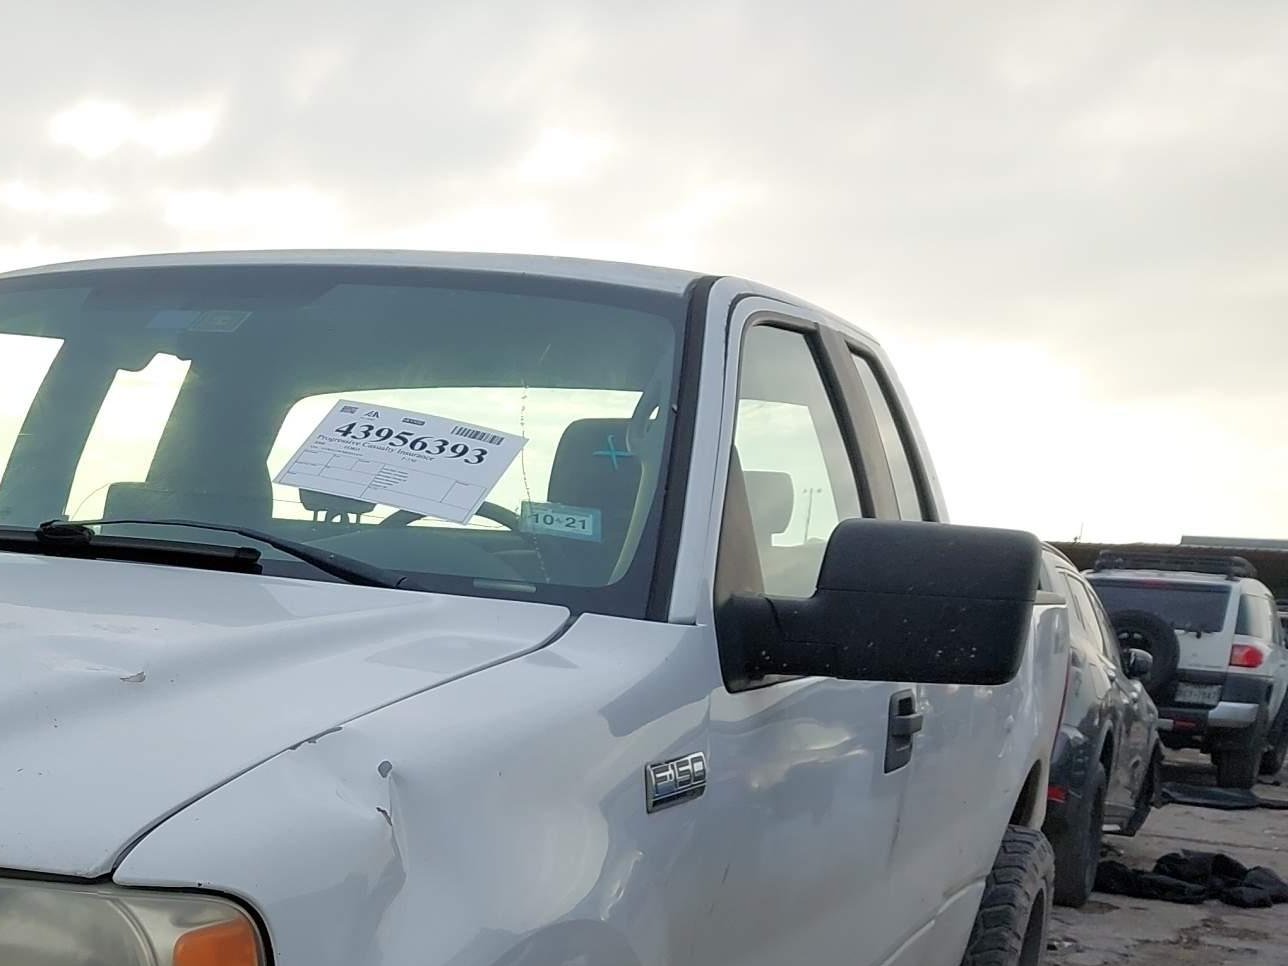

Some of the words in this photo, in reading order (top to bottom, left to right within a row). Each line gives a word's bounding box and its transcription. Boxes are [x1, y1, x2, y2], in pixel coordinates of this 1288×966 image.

[317, 434, 361, 446] Progressive
[362, 441, 395, 454] Casualty
[396, 448, 435, 461] Insurance
[335, 421, 488, 464] 43956393
